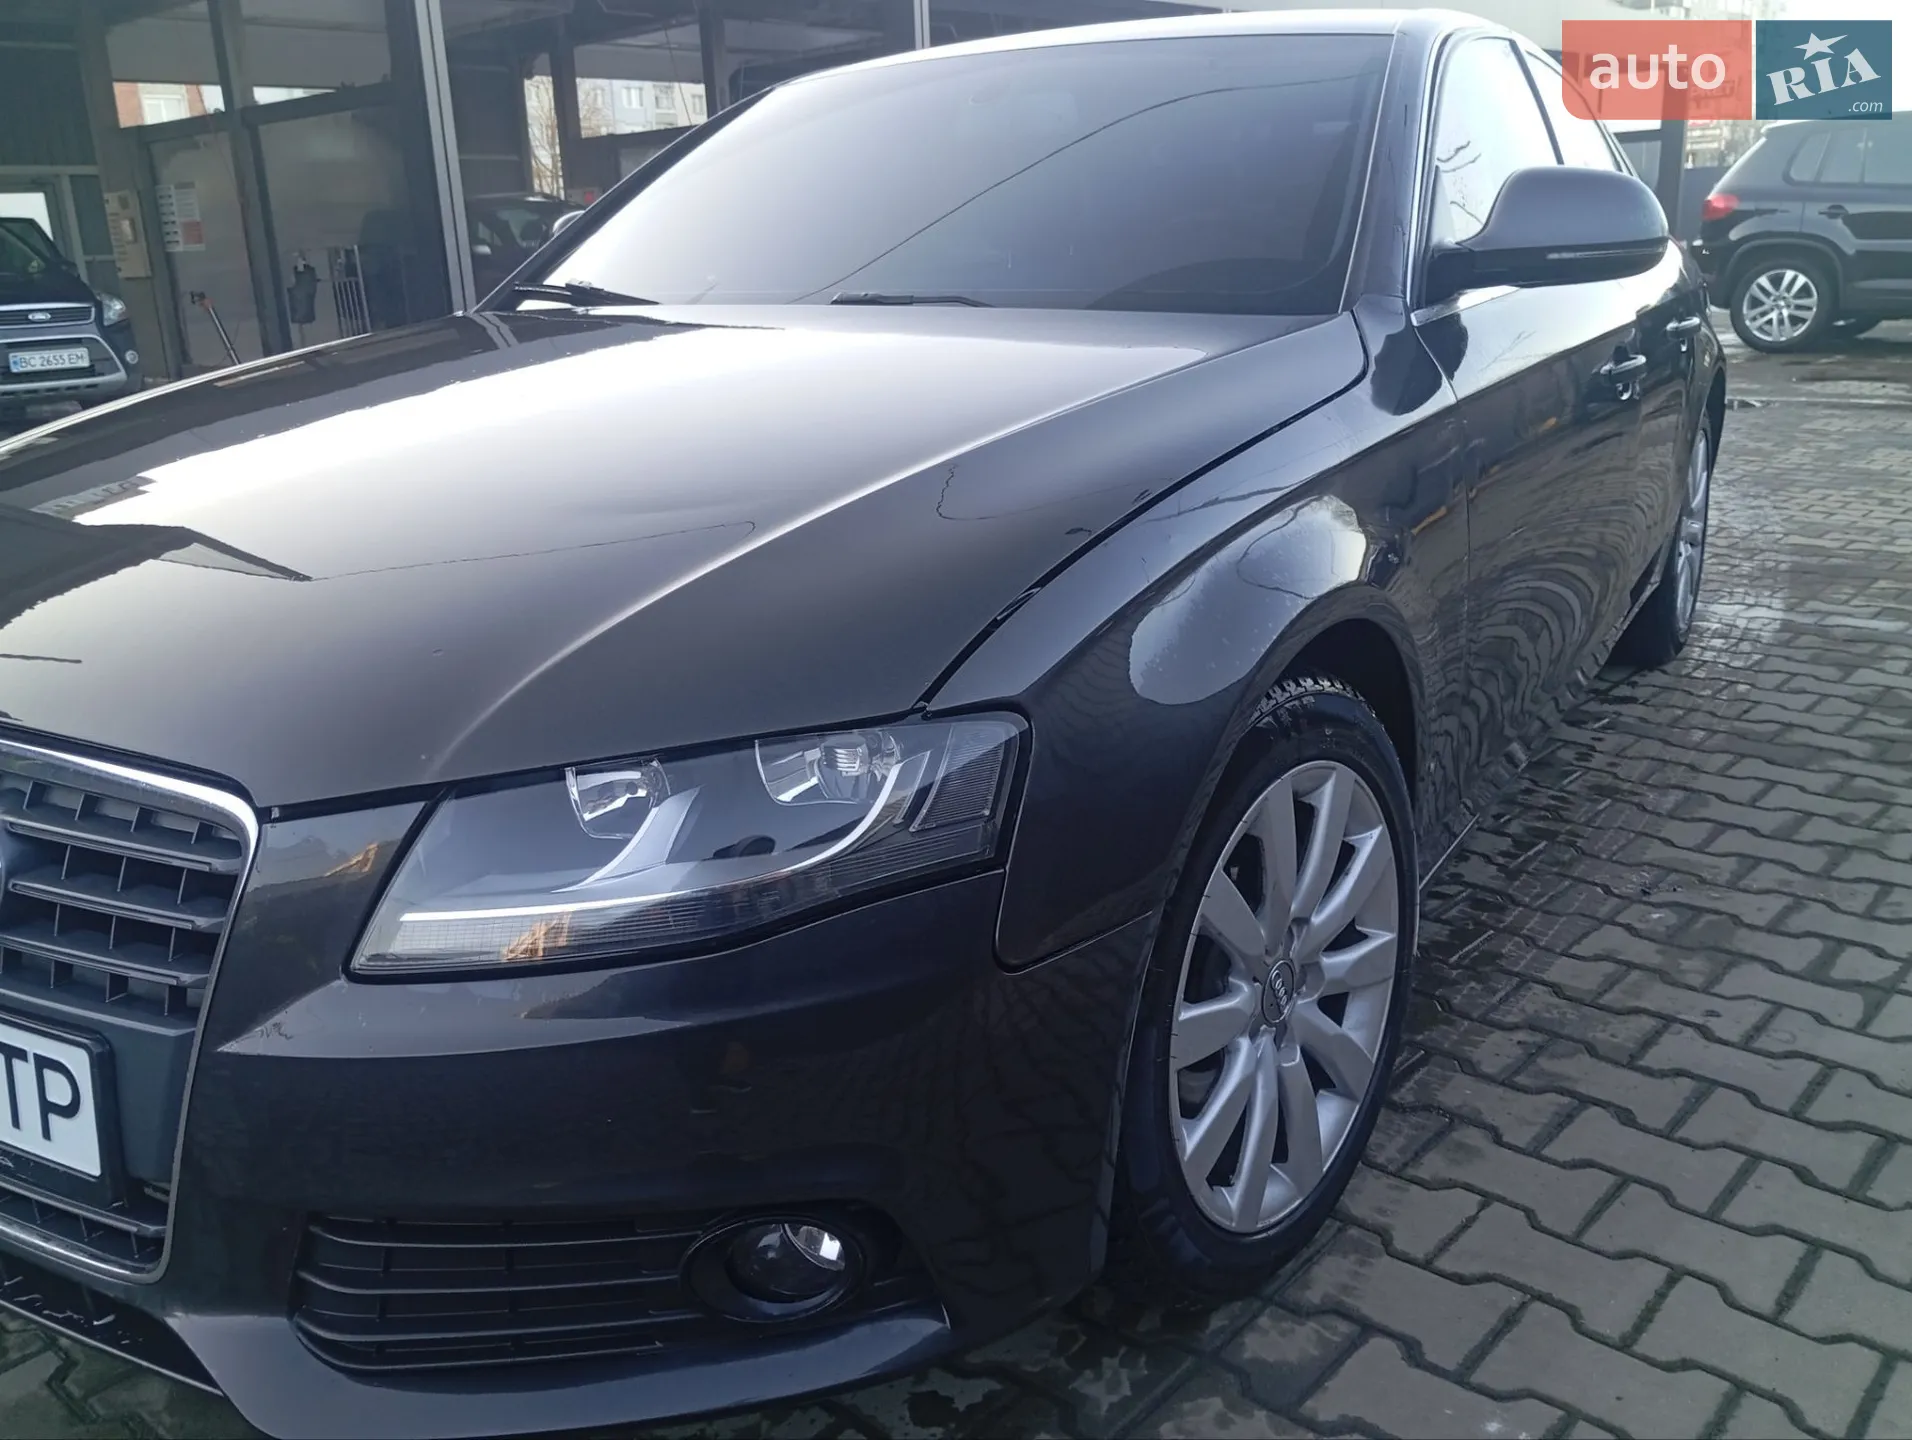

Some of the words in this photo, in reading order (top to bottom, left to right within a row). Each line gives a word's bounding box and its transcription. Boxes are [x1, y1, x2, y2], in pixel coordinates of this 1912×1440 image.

[19, 356, 36, 369] BC
[39, 353, 66, 367] 2655
[0, 1041, 81, 1141] TP
